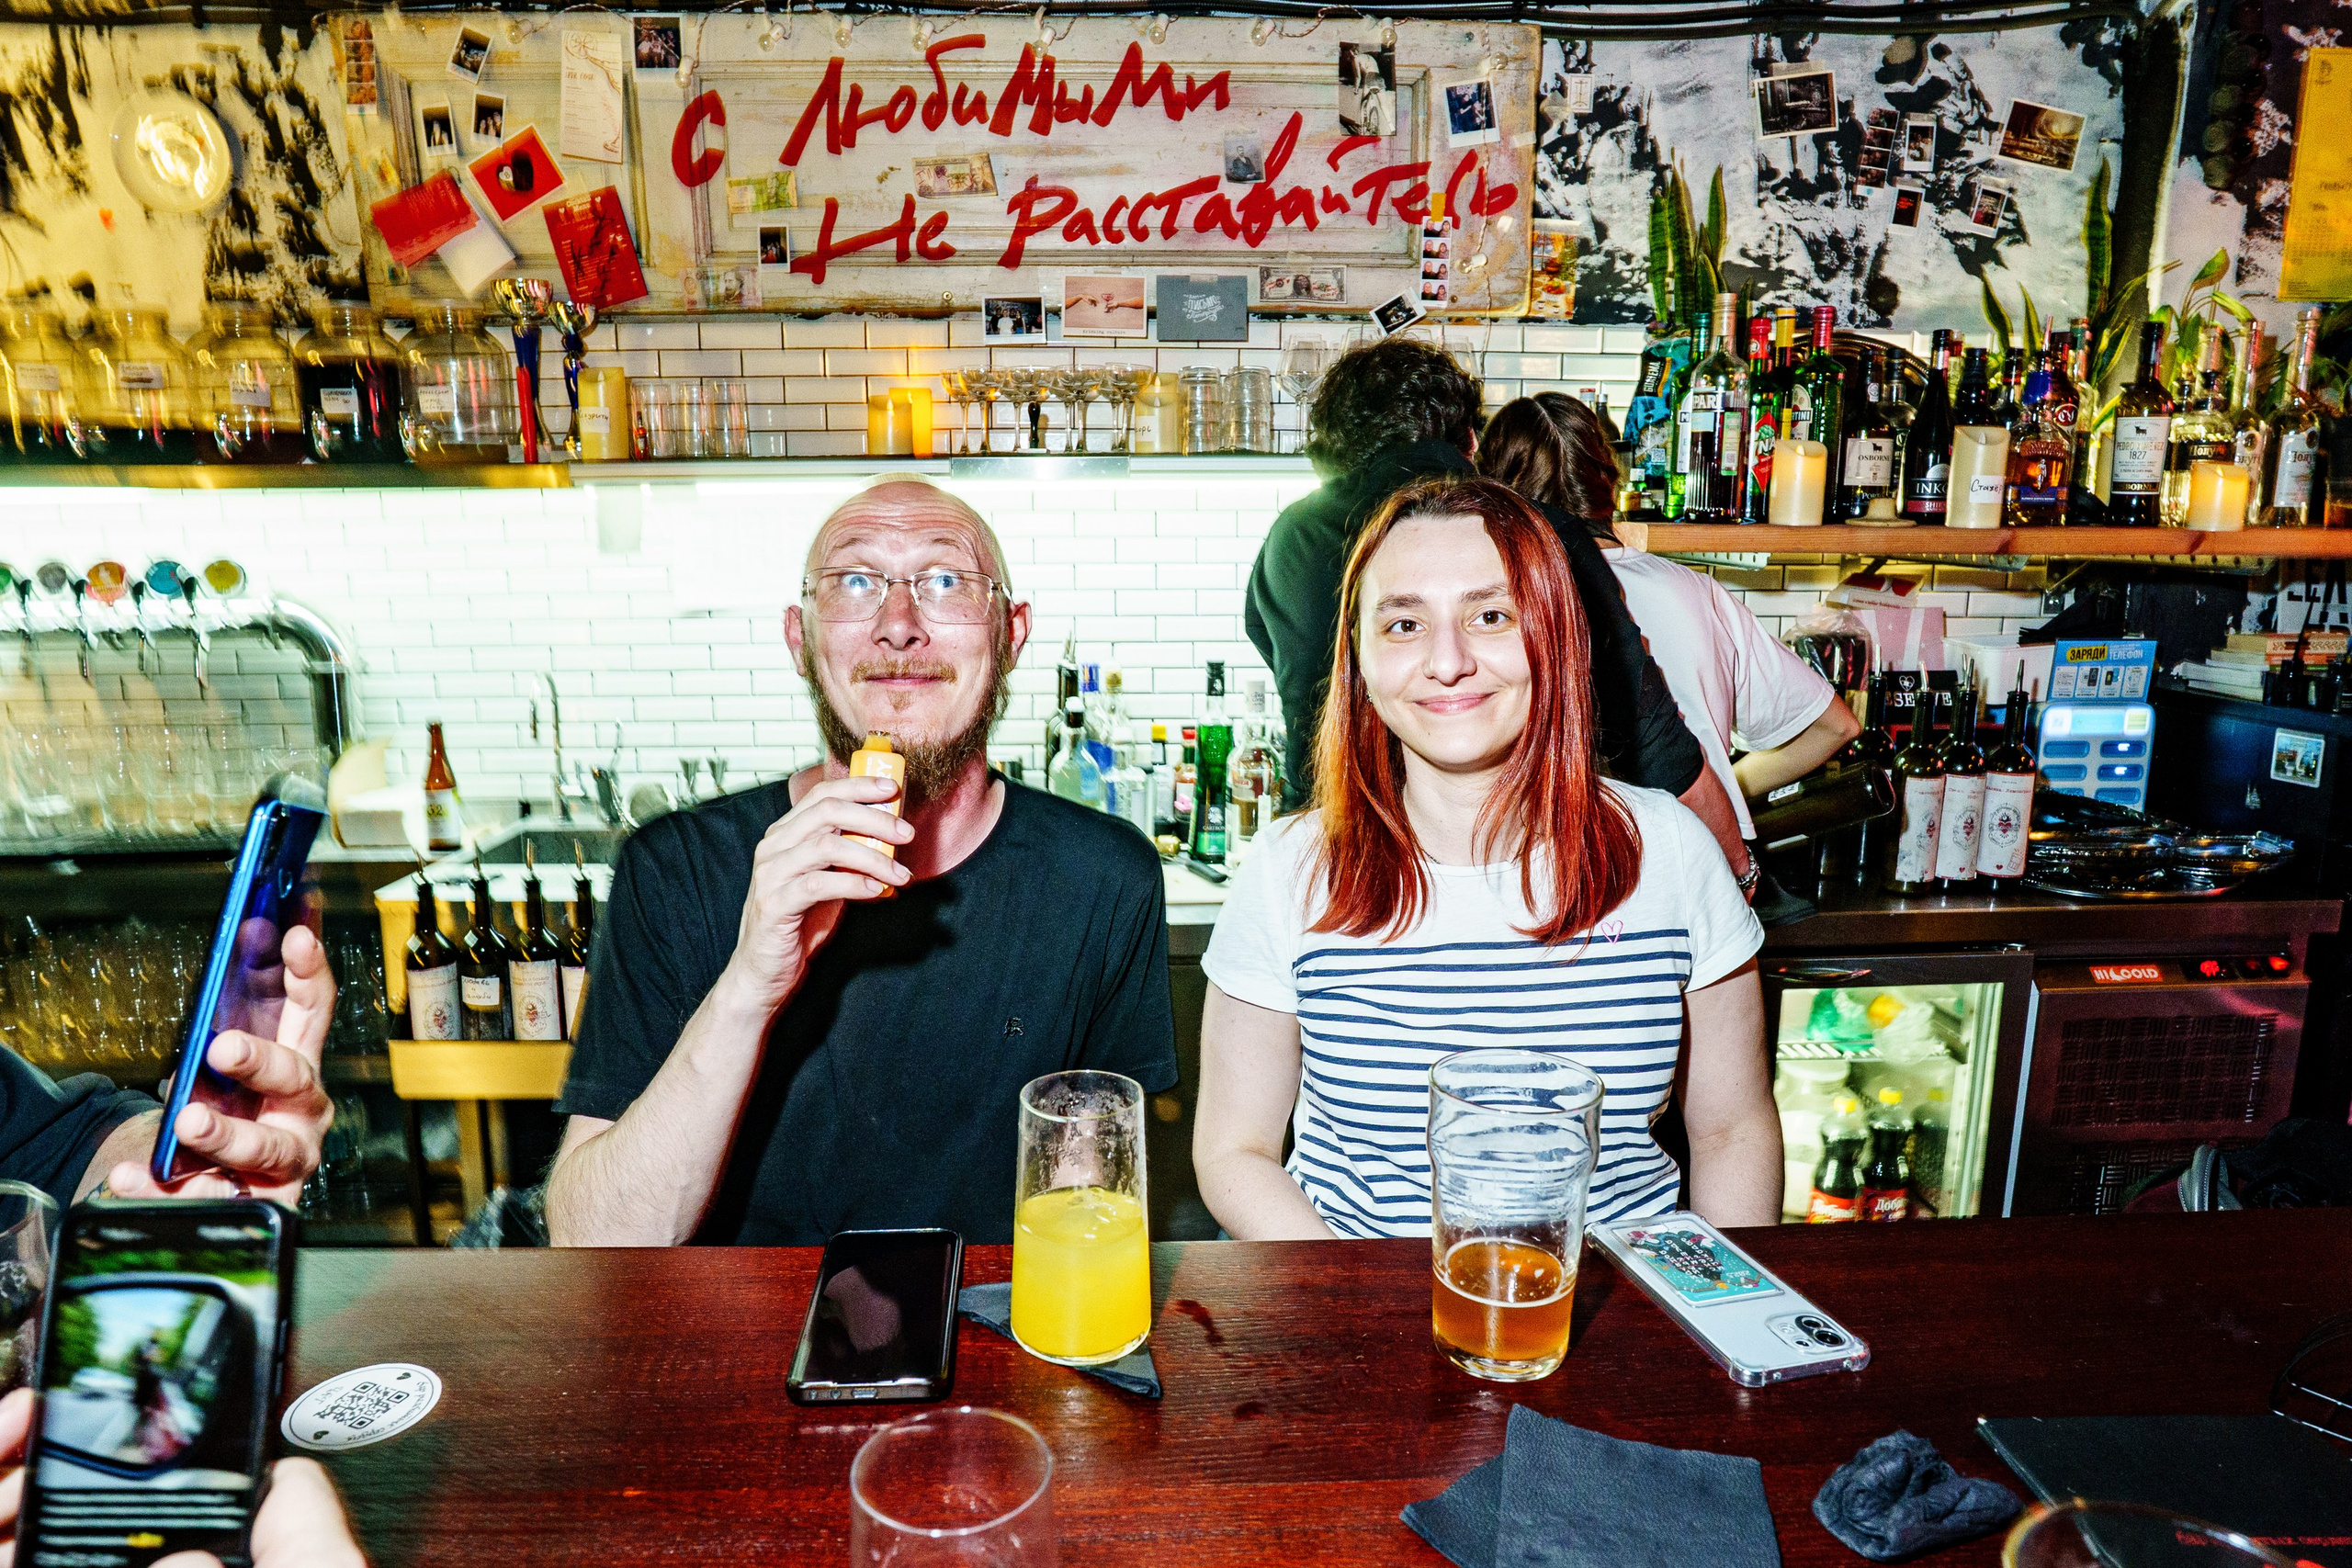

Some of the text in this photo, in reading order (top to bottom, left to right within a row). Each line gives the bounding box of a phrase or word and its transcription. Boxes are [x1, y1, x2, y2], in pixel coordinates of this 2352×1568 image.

[672, 89, 726, 187] С
[790, 193, 956, 285] Не
[2129, 451, 2146, 459] 1827
[2070, 647, 2106, 660] ЗАРЯДИ
[2109, 650, 2143, 660] ТЕЛЕФОН
